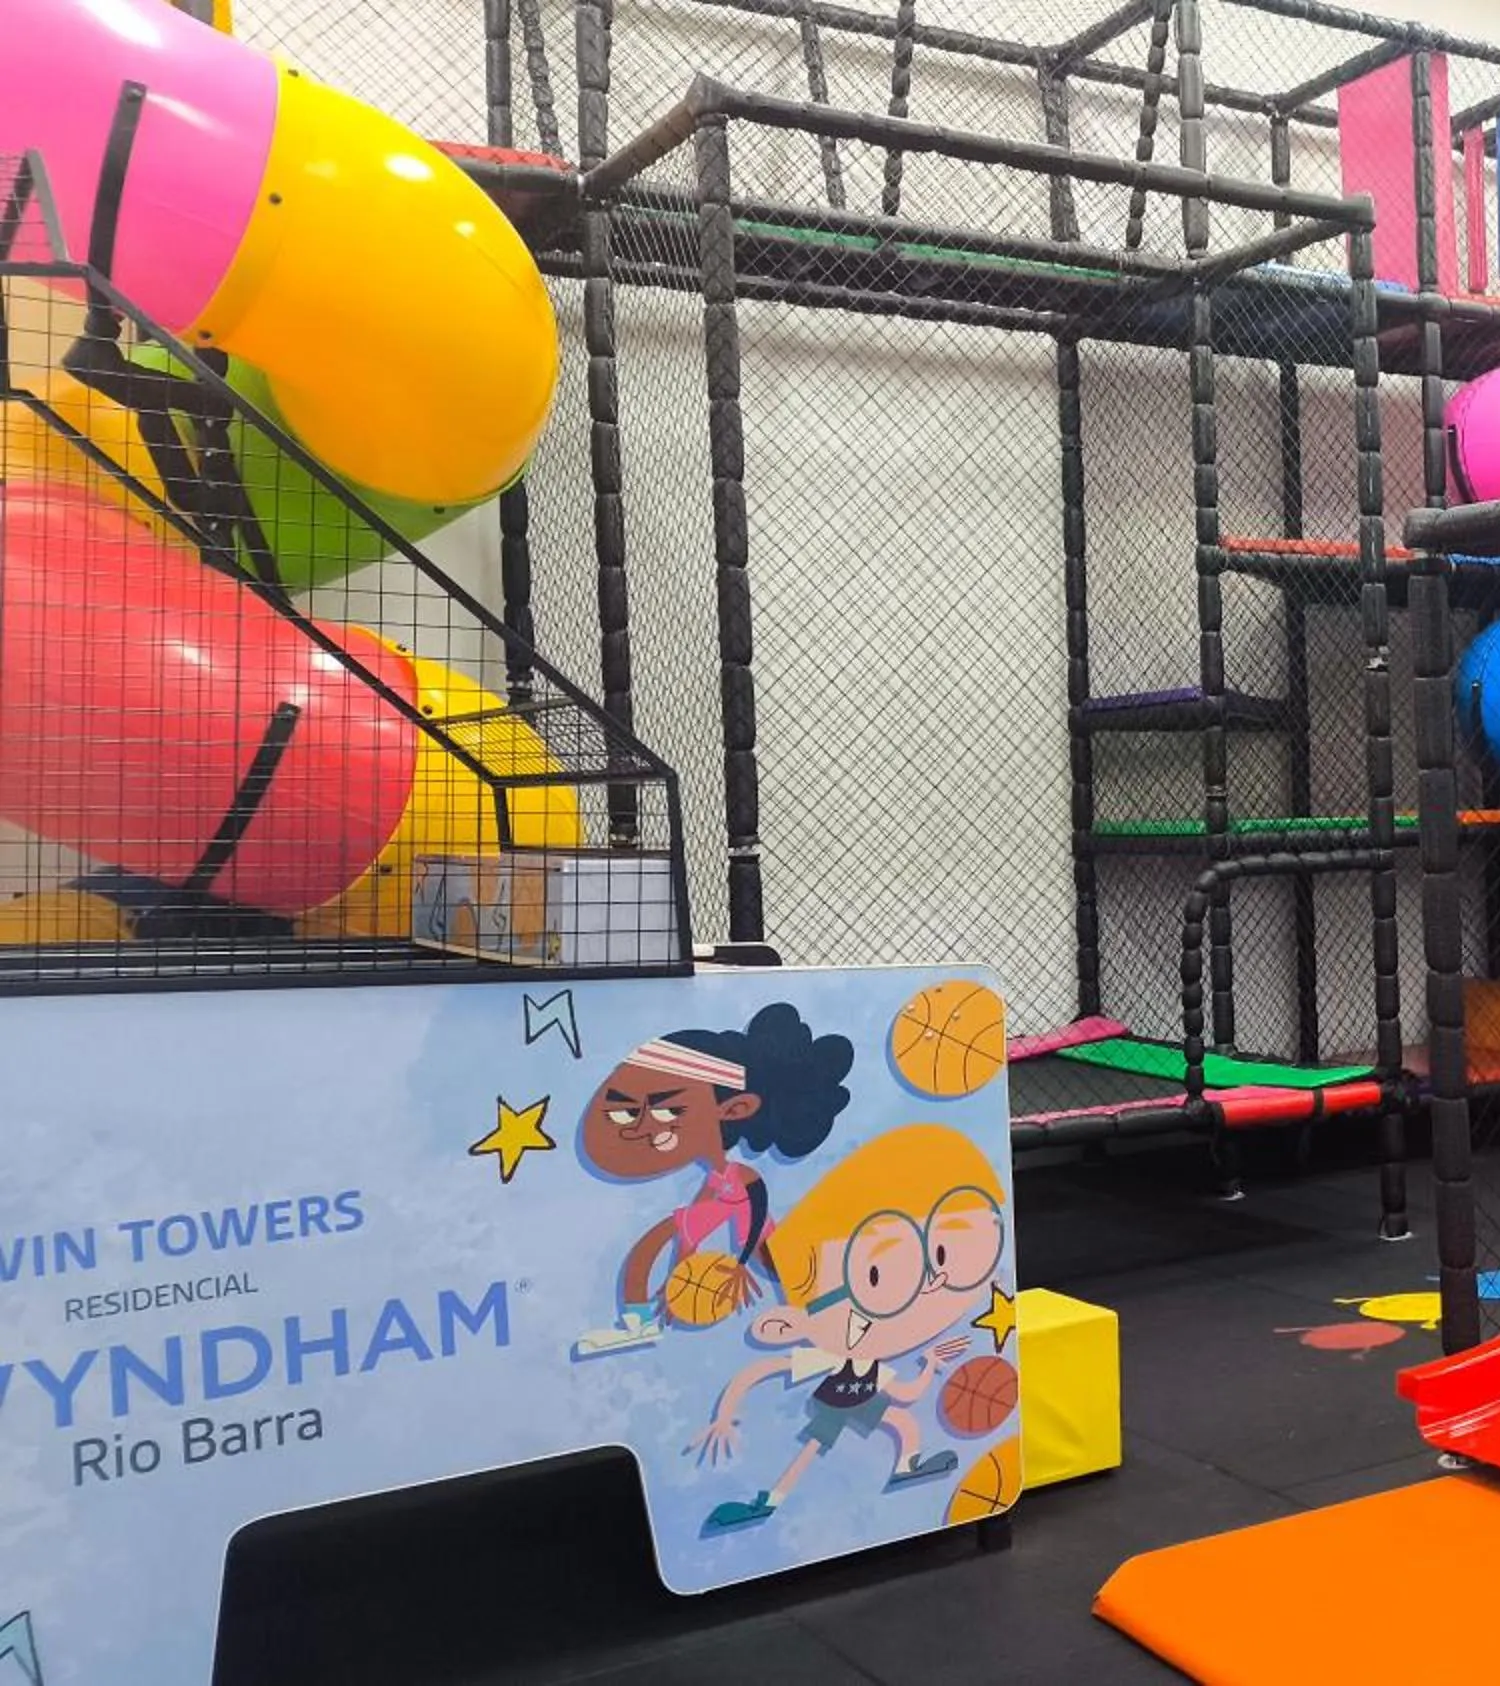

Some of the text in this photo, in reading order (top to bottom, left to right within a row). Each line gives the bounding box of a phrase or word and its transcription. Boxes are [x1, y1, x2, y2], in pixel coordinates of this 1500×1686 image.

[118, 1190, 365, 1263] TOWERS
[64, 1272, 259, 1322] RESIDENCIAL
[0, 1281, 511, 1428] YNDHAM
[72, 1408, 325, 1487] Rio Barra
